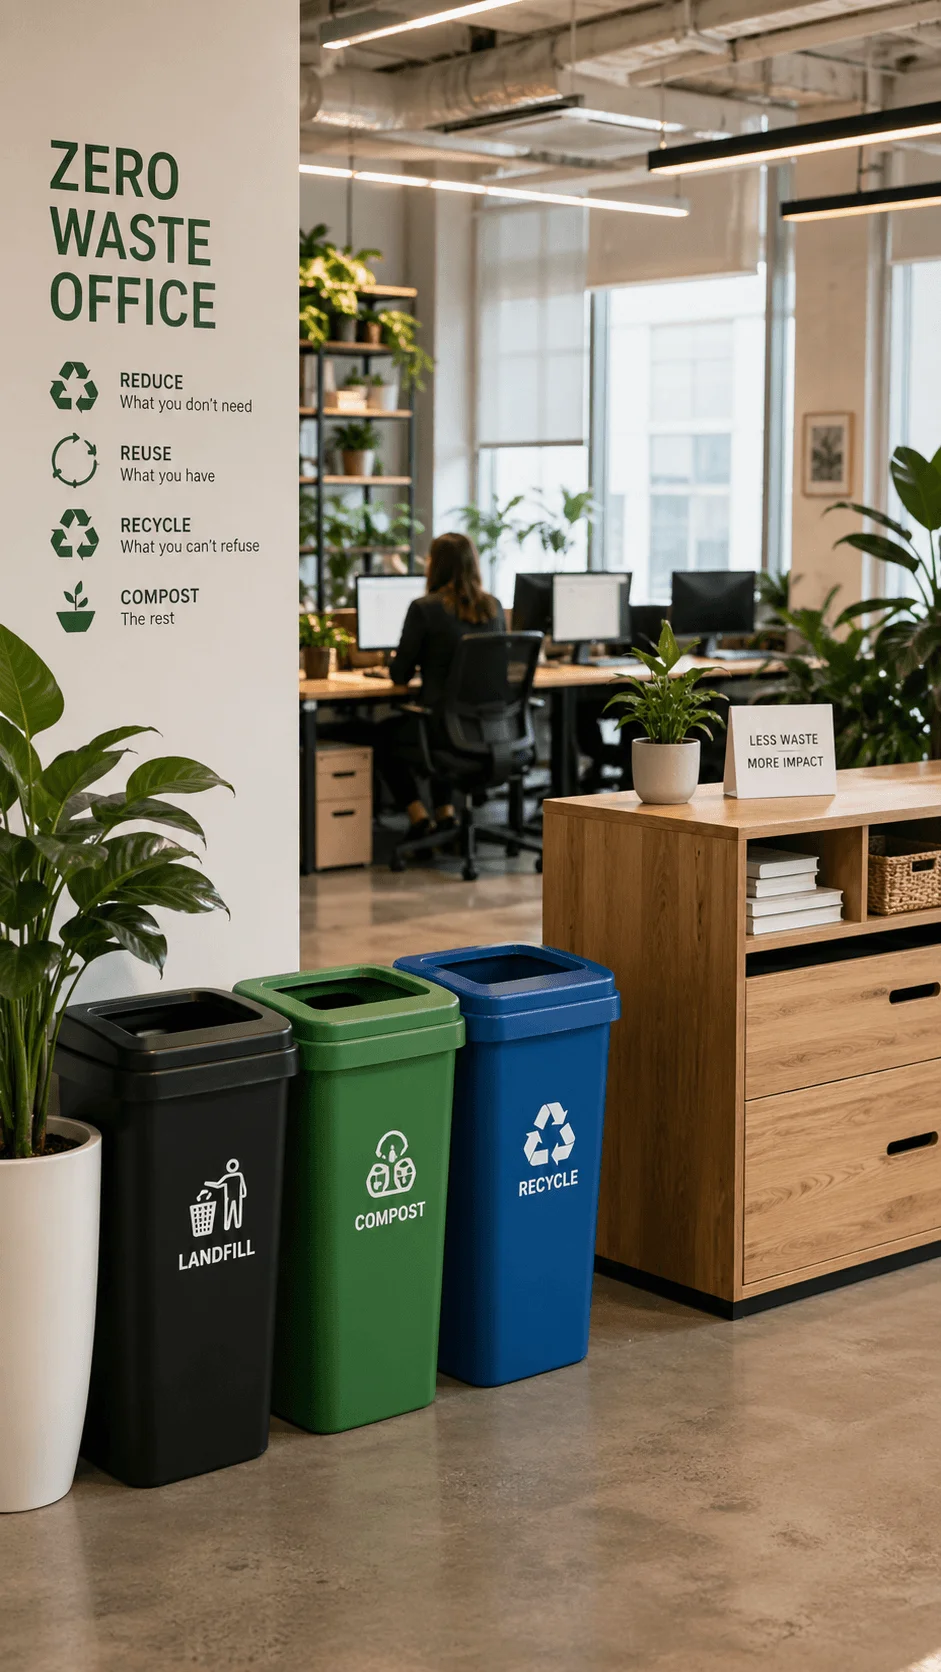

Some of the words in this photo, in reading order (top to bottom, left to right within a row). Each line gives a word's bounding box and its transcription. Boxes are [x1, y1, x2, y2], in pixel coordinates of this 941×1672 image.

[50, 140, 179, 200] ZERO
[50, 206, 211, 266] WASTE
[50, 272, 216, 329] OFFICE
[120, 372, 184, 390] REDUCE
[120, 395, 155, 410] What
[158, 399, 182, 414] you
[186, 397, 218, 412] don't
[221, 399, 253, 413] need
[120, 445, 172, 461] REUSE
[120, 468, 155, 482] What
[158, 471, 182, 485] you
[186, 468, 216, 482] have
[120, 517, 192, 533] RECYCLE
[120, 540, 156, 554] What
[158, 543, 182, 556] you
[186, 539, 217, 553] can't
[220, 538, 260, 552] refuse
[120, 588, 200, 605] COMPOST
[121, 612, 146, 626] The
[150, 612, 175, 625] rest
[749, 734, 777, 746] LESS
[780, 733, 819, 745] WASTE
[747, 757, 779, 769] MORE
[783, 756, 824, 768] IMPACT
[518, 1169, 579, 1197] RECYCLE
[354, 1200, 426, 1231] COMPOST
[178, 1239, 256, 1271] LANDFILL
